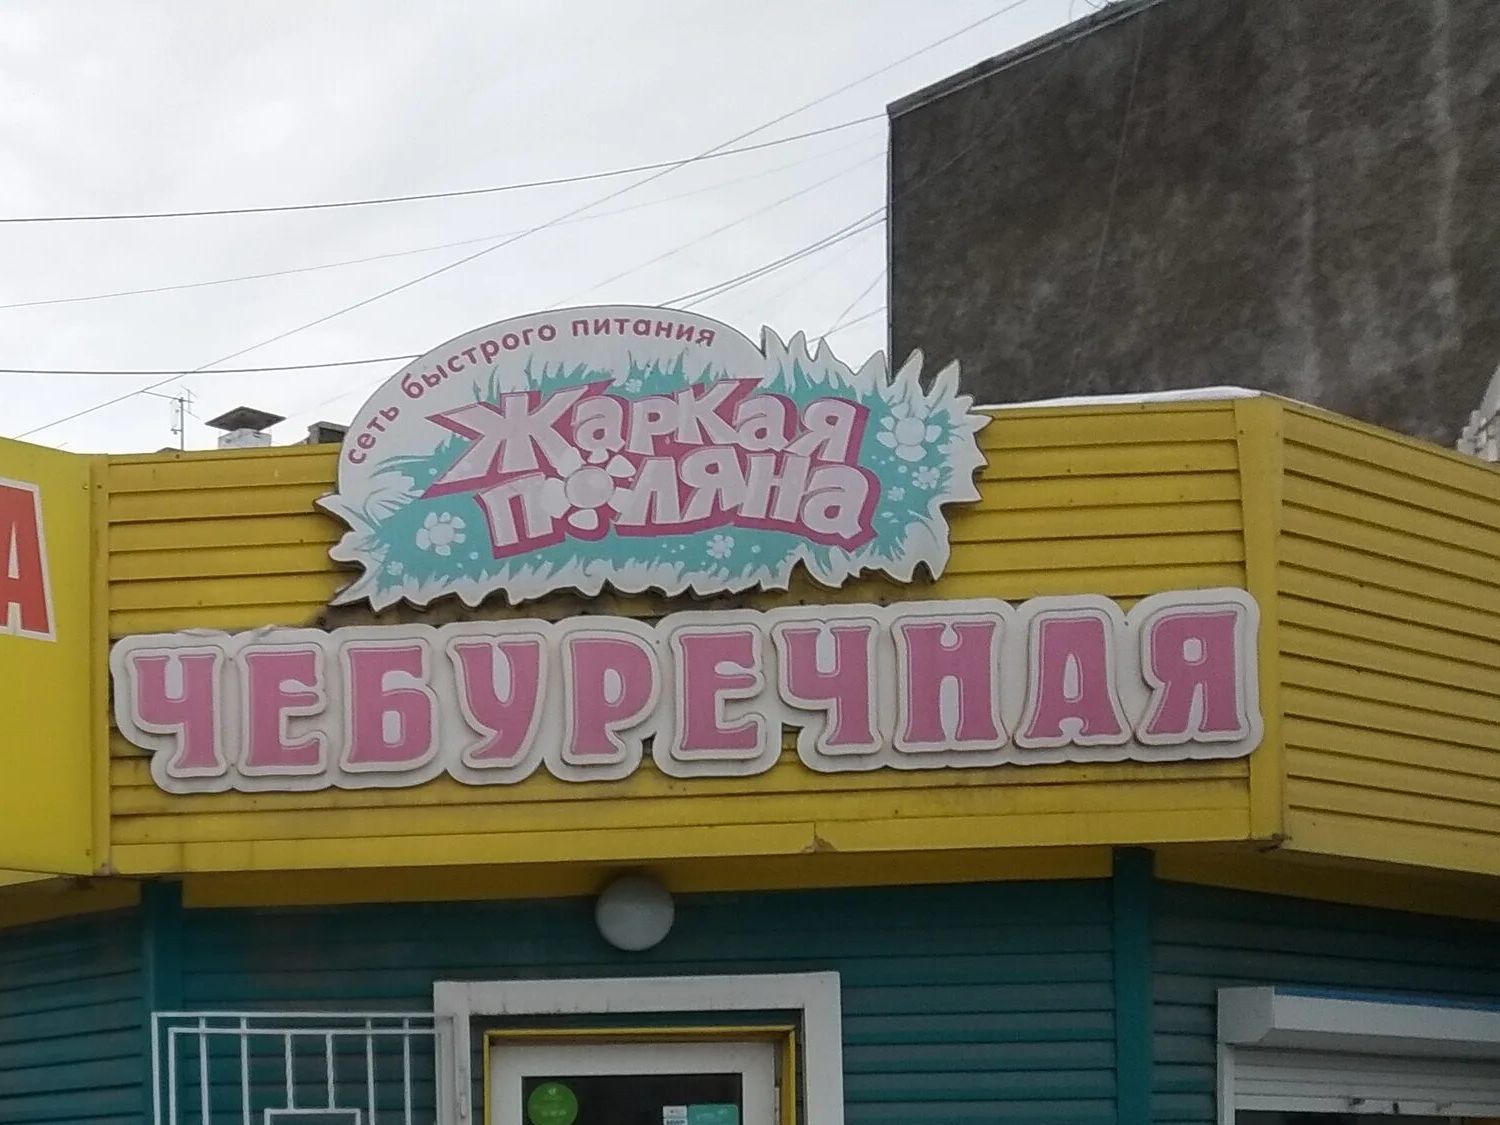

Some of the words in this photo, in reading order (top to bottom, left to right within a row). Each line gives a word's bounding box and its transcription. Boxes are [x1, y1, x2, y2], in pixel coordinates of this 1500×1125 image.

[348, 406, 401, 465] сеть
[399, 324, 558, 399] быстрого
[571, 316, 717, 347] питания
[128, 606, 1246, 774] ЧЕБУРЕЧНАЯ
